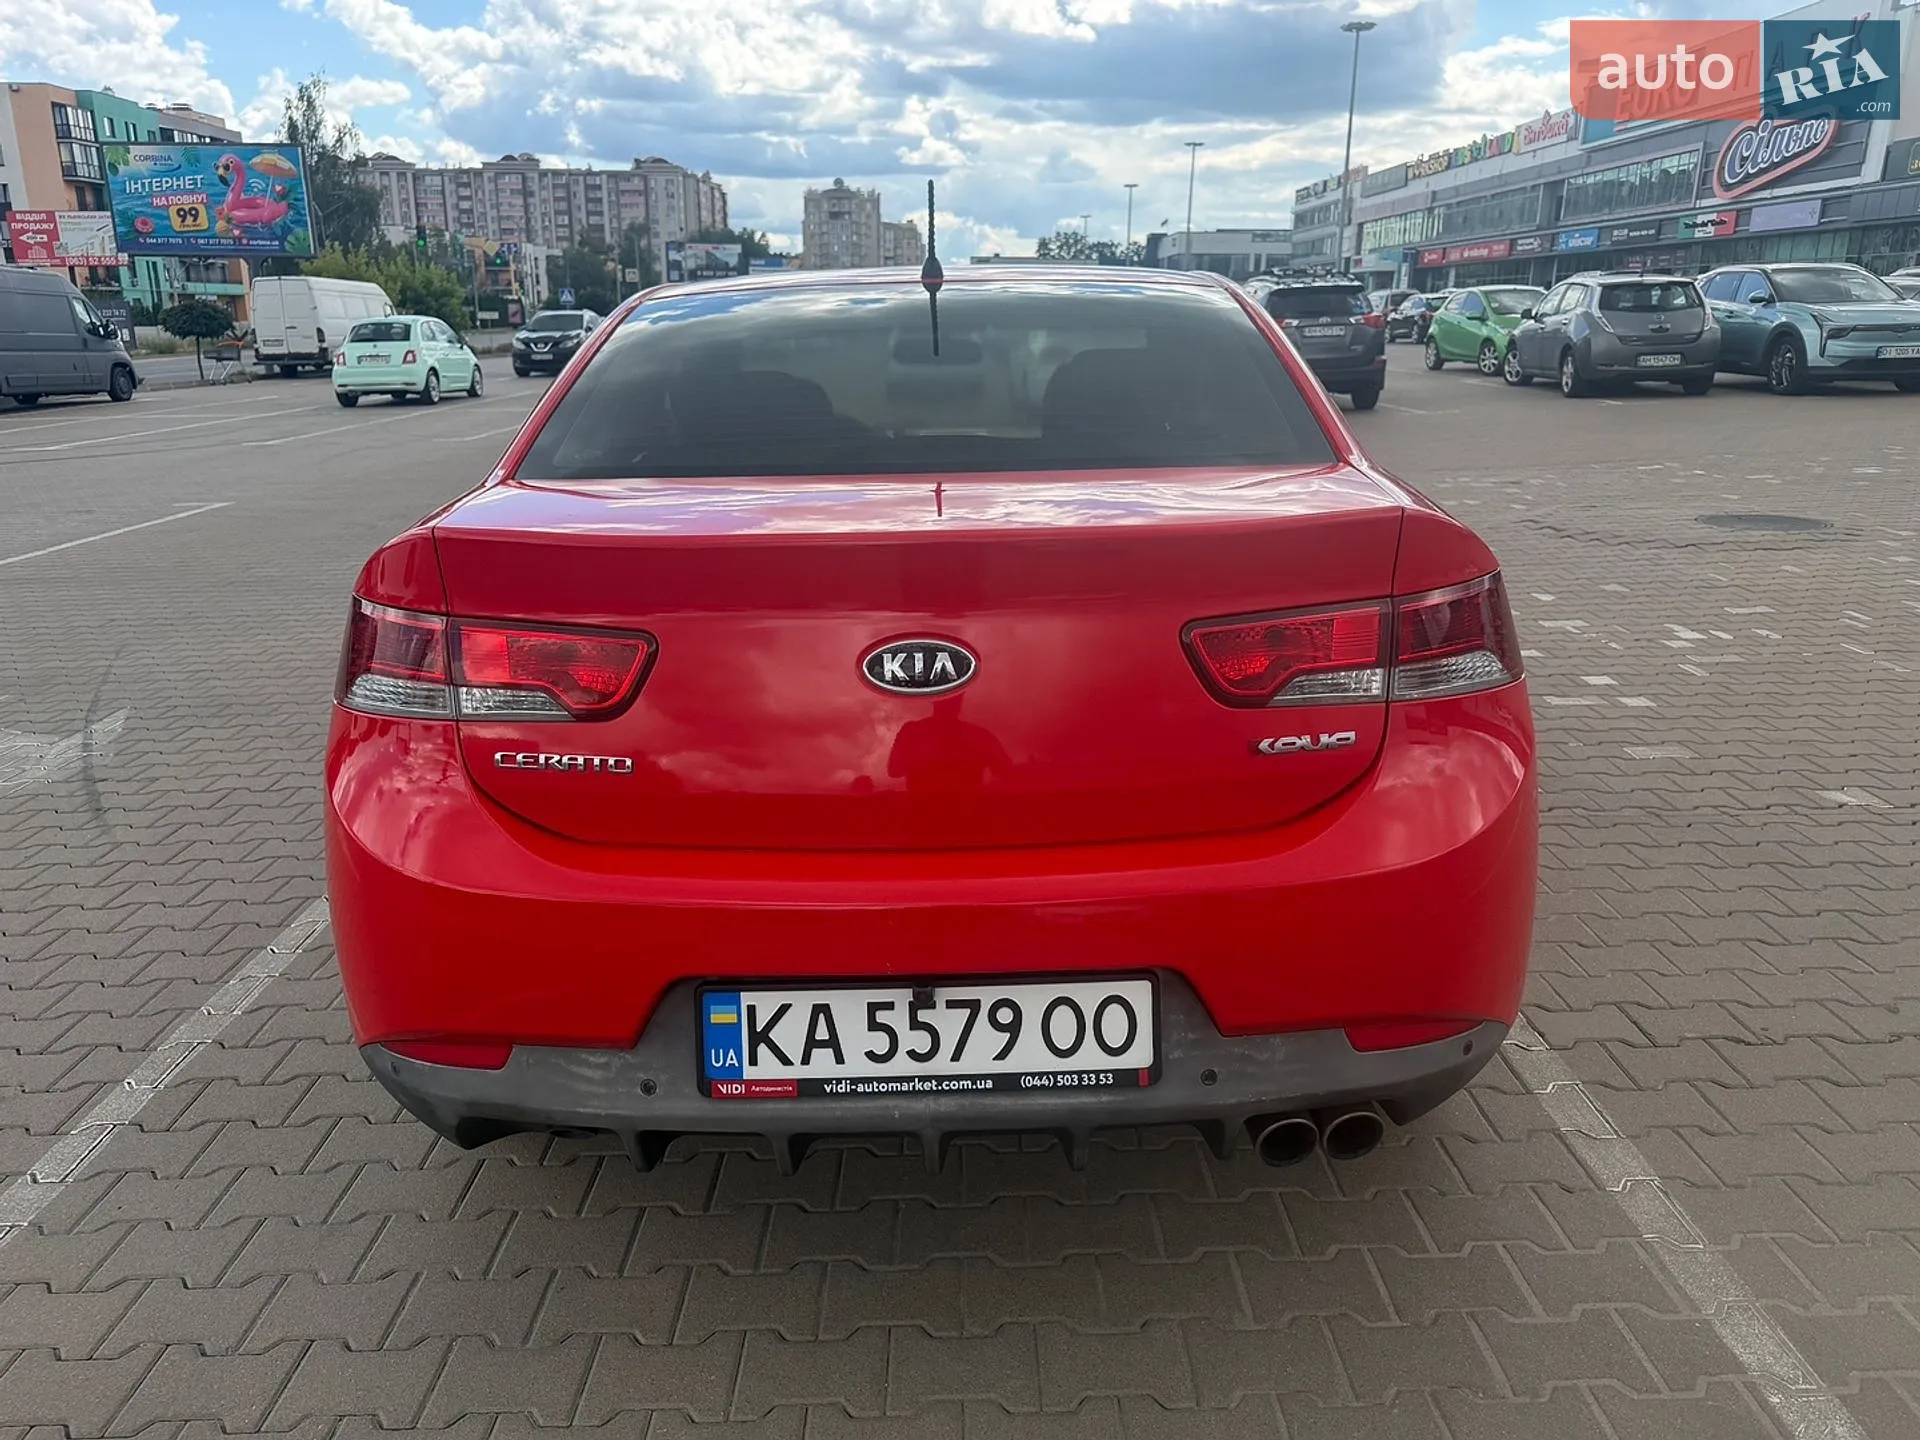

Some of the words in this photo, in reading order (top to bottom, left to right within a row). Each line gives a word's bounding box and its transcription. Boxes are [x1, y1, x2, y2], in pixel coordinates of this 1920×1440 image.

[1724, 117, 1830, 184] Сільпо
[126, 175, 203, 193] ІНТЕРНЕТ
[153, 196, 168, 206] НА
[169, 194, 208, 204] ПОВНУ!
[176, 206, 200, 223] 99
[11, 222, 55, 230] ПРОДАЖУ
[882, 652, 957, 680] KIA
[494, 751, 633, 773] CERATO
[745, 1001, 846, 1067] KA
[863, 997, 1024, 1064] 5579
[1041, 994, 1138, 1059] OO
[710, 1048, 739, 1068] UA
[717, 1083, 746, 1095] VIDI
[823, 1077, 993, 1093] vidi-automarket.com.ua
[1020, 1074, 1054, 1088] (044)
[1056, 1074, 1079, 1087] 503
[1081, 1073, 1097, 1086] 33
[1099, 1073, 1114, 1085] 53
